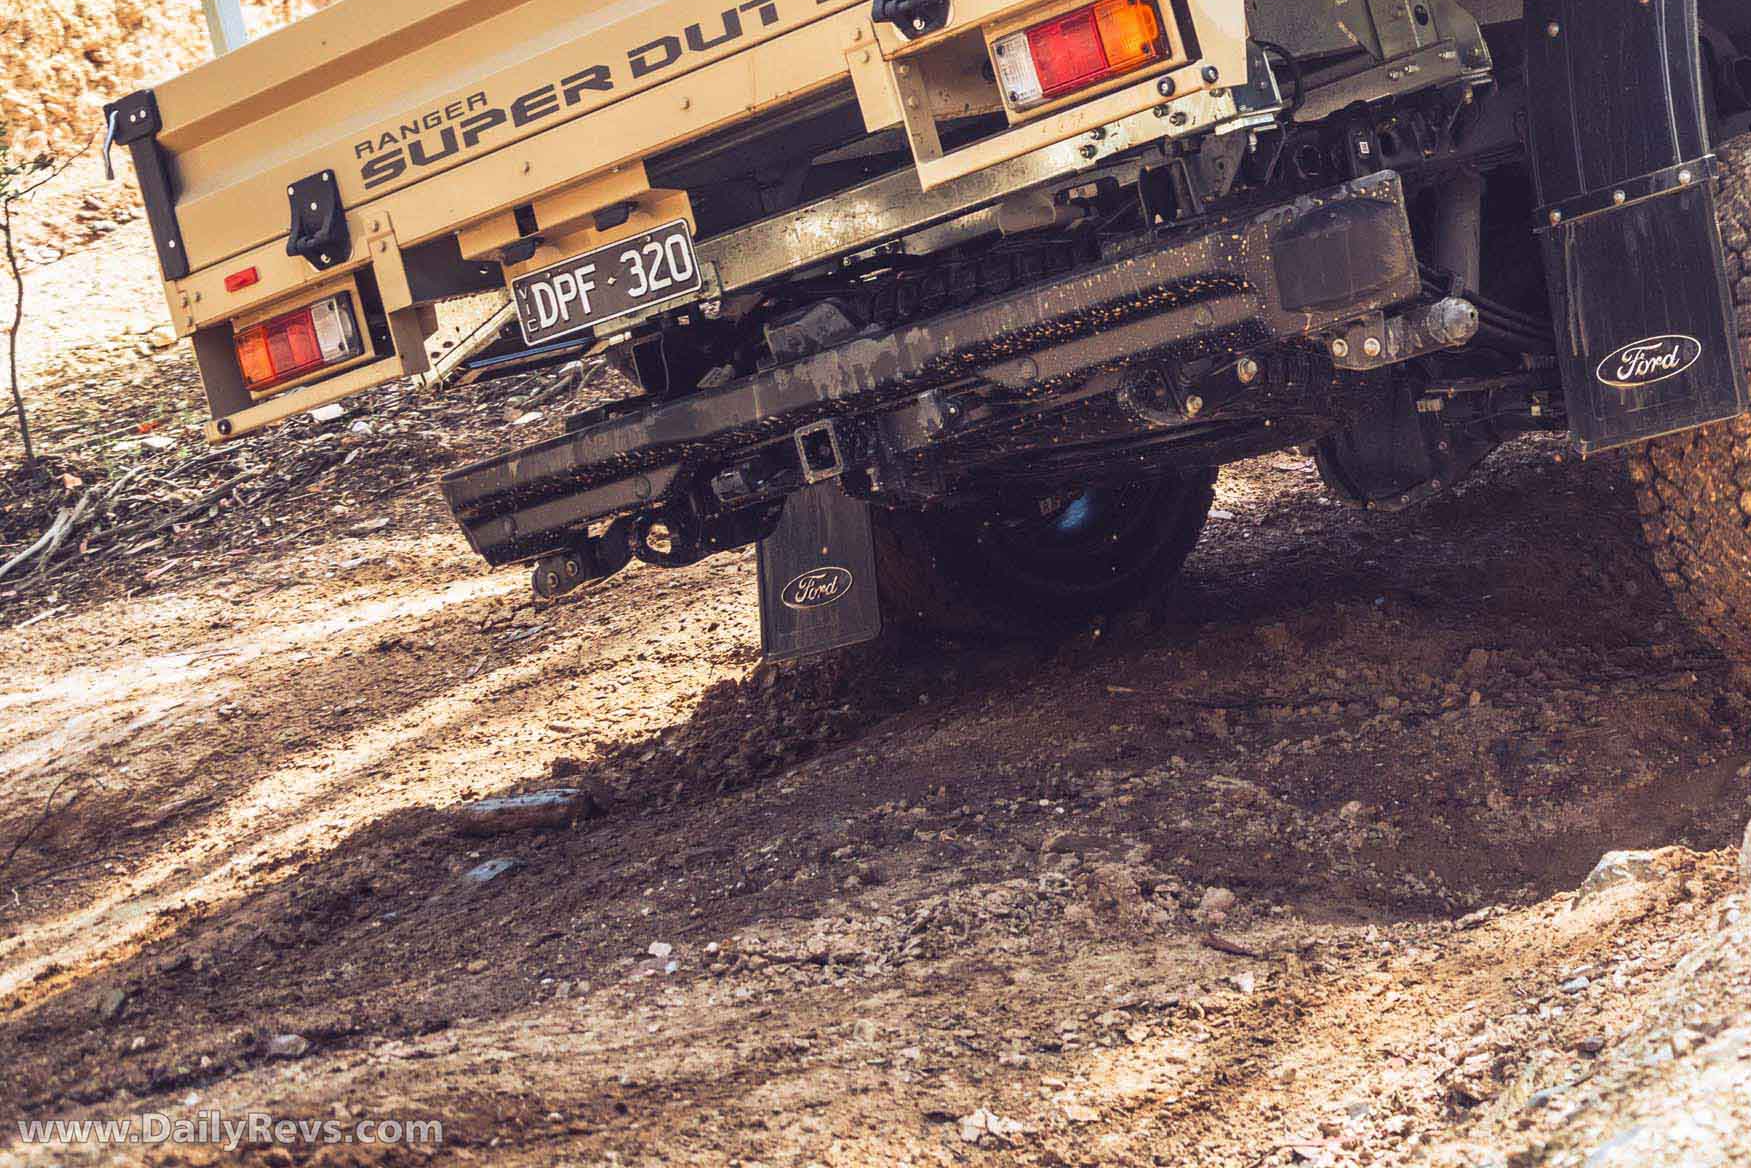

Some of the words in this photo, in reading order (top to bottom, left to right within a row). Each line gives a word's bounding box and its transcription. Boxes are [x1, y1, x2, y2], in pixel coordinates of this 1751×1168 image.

[355, 91, 488, 159] RANGER
[361, 64, 615, 190] SUPER
[531, 263, 597, 329] DPF
[620, 233, 694, 298] 320
[1616, 342, 1680, 381] Ford
[795, 572, 839, 603] Ford
